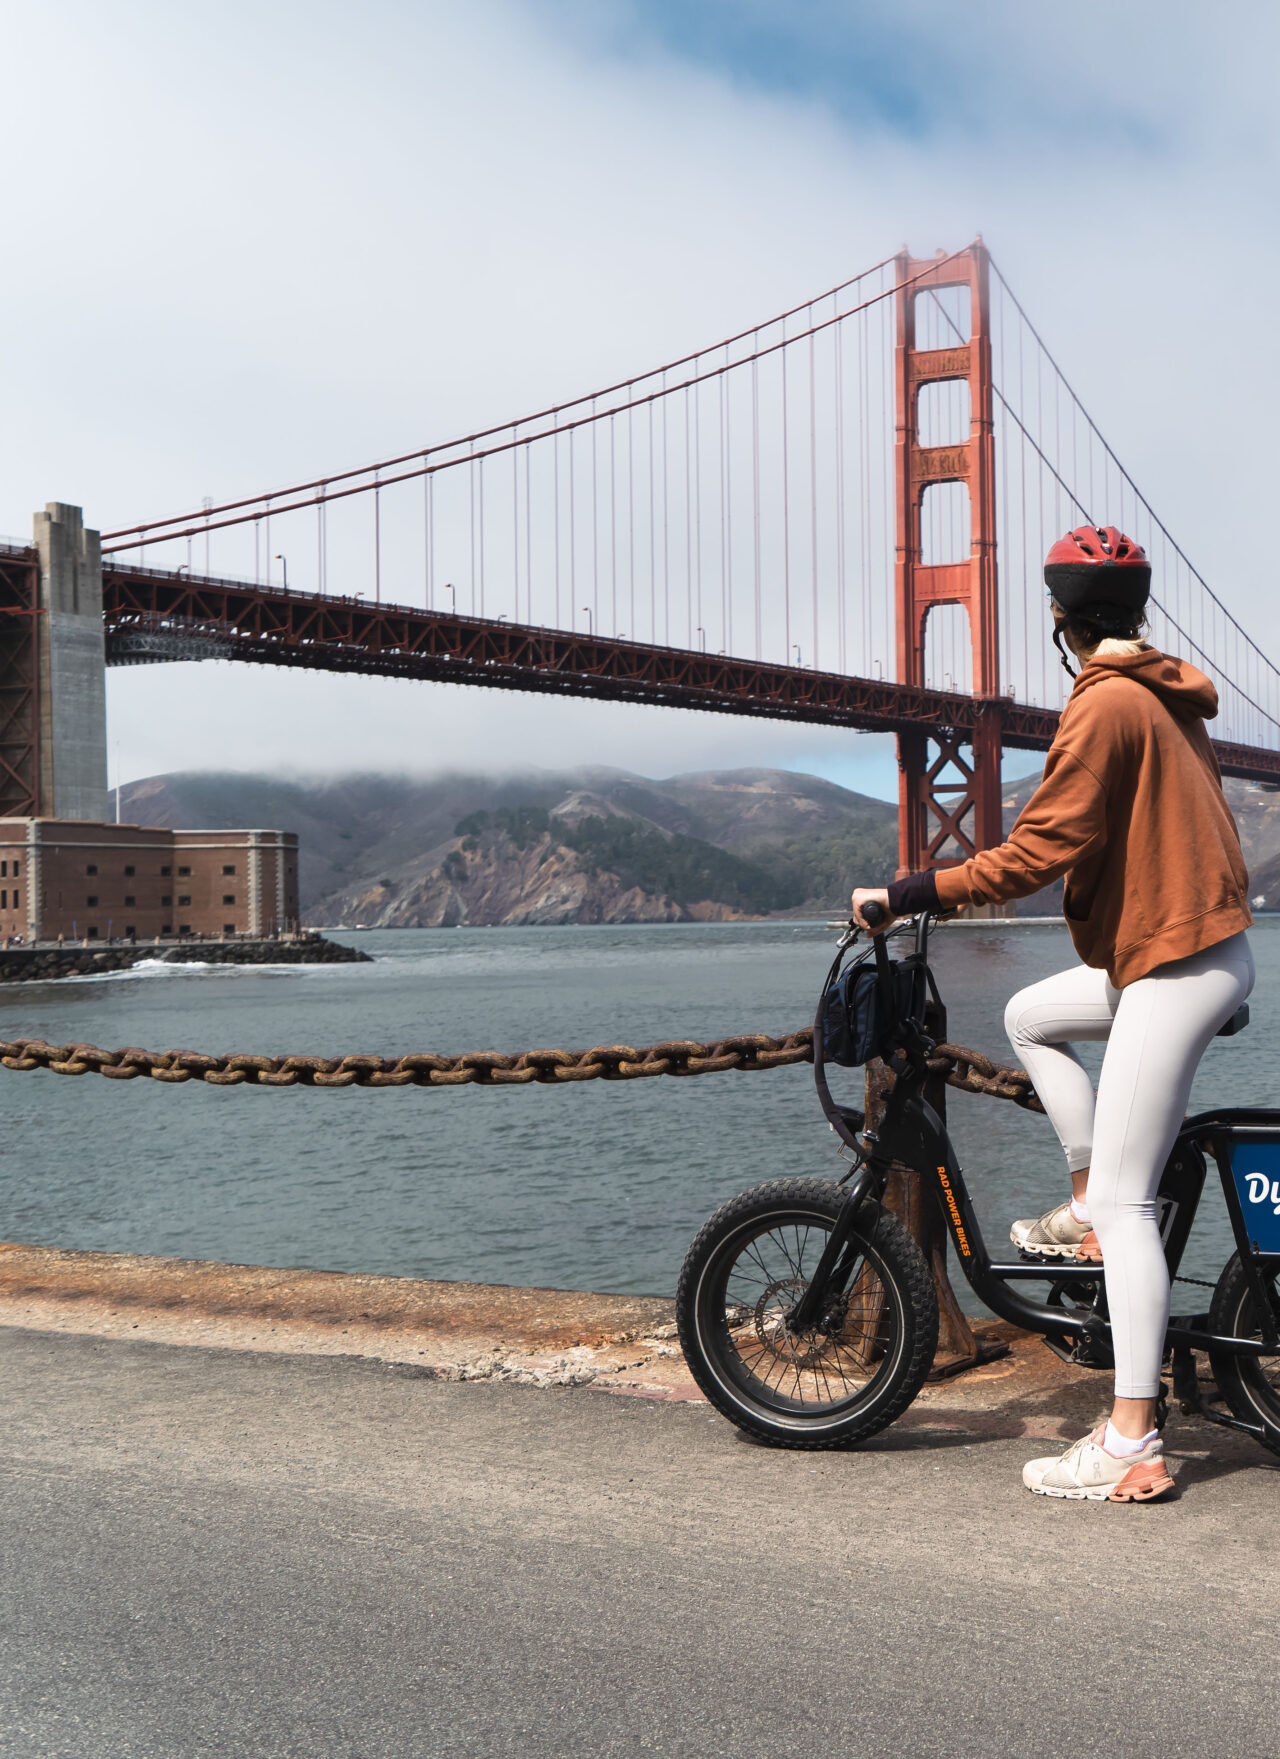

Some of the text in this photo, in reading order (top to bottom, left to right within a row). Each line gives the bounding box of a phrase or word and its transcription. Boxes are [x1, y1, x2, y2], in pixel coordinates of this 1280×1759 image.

[937, 1166, 971, 1257] RAD POWER BIKES
